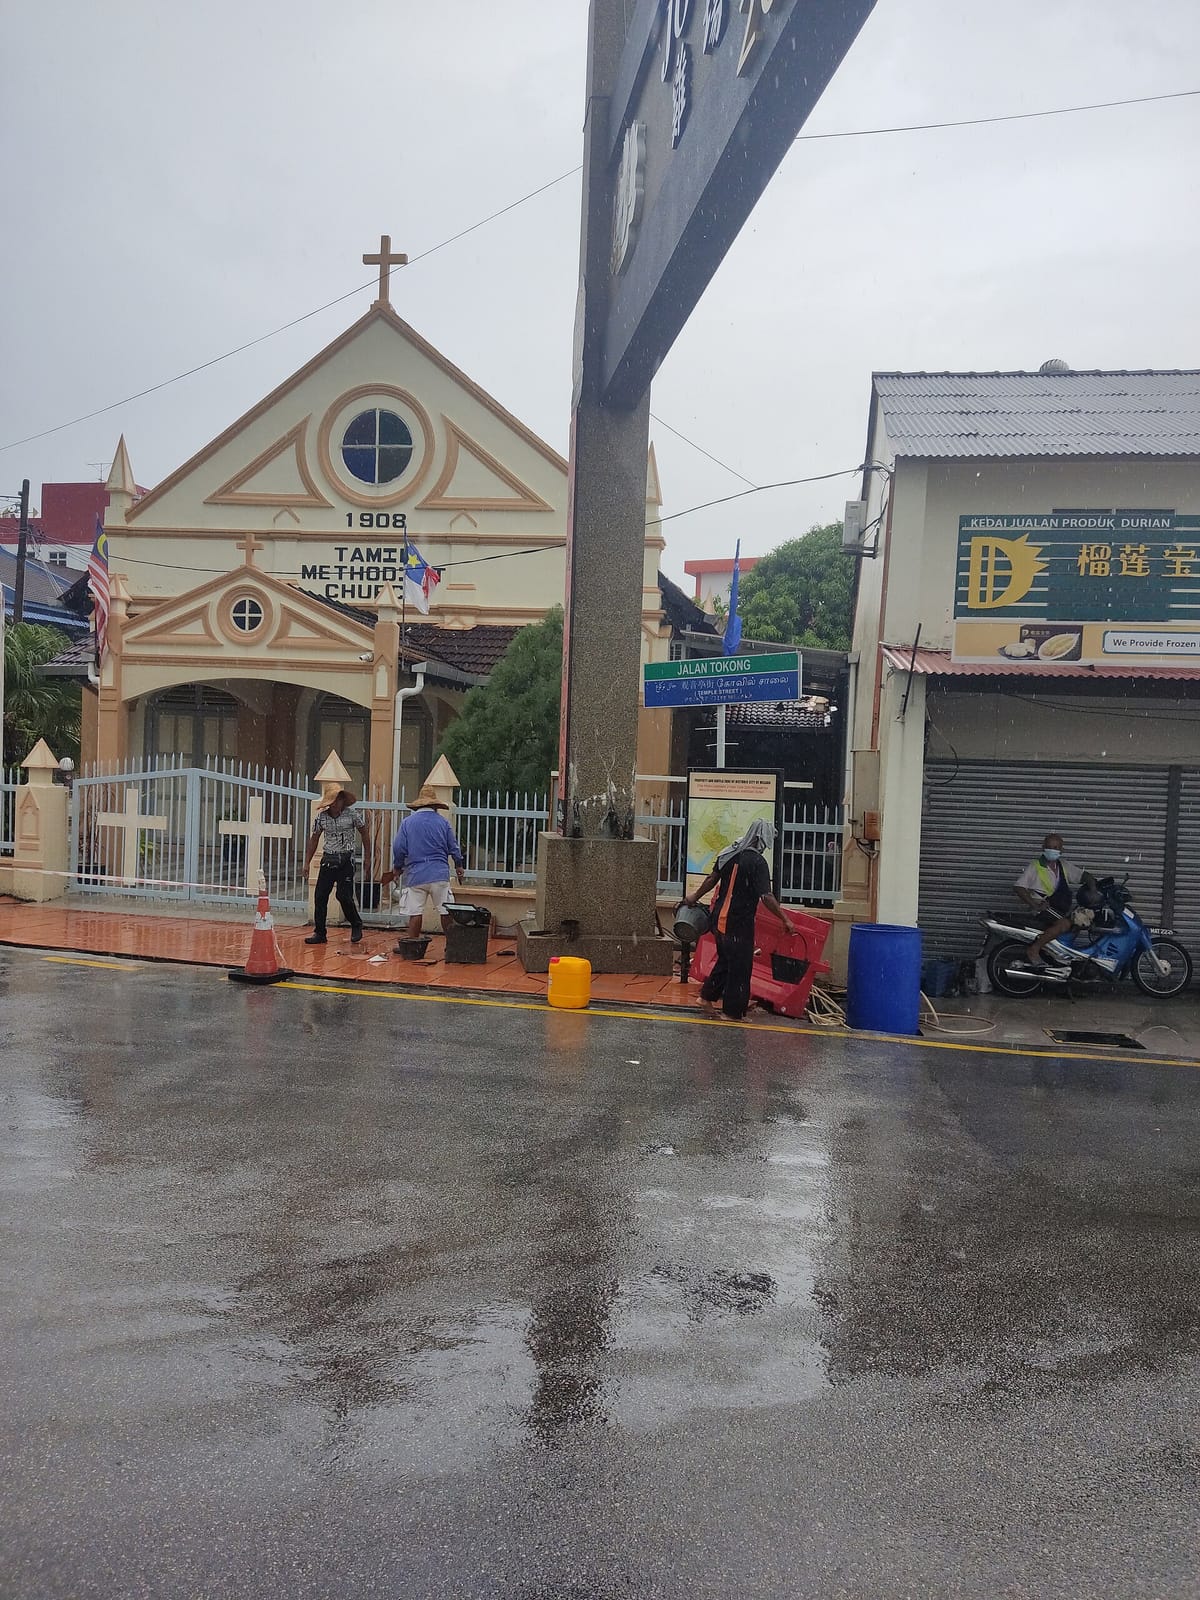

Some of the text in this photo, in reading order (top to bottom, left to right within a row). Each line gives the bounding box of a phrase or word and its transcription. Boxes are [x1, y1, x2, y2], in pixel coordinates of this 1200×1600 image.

[346, 512, 407, 528] 1908
[971, 517, 1170, 528] KEDAI JUALAN PRODUK DURIAN
[301, 564, 447, 582] METHODT
[325, 583, 405, 600] CHUC
[1113, 639, 1196, 648] We Provide Frozen
[677, 659, 751, 675] JALAN TOKONG
